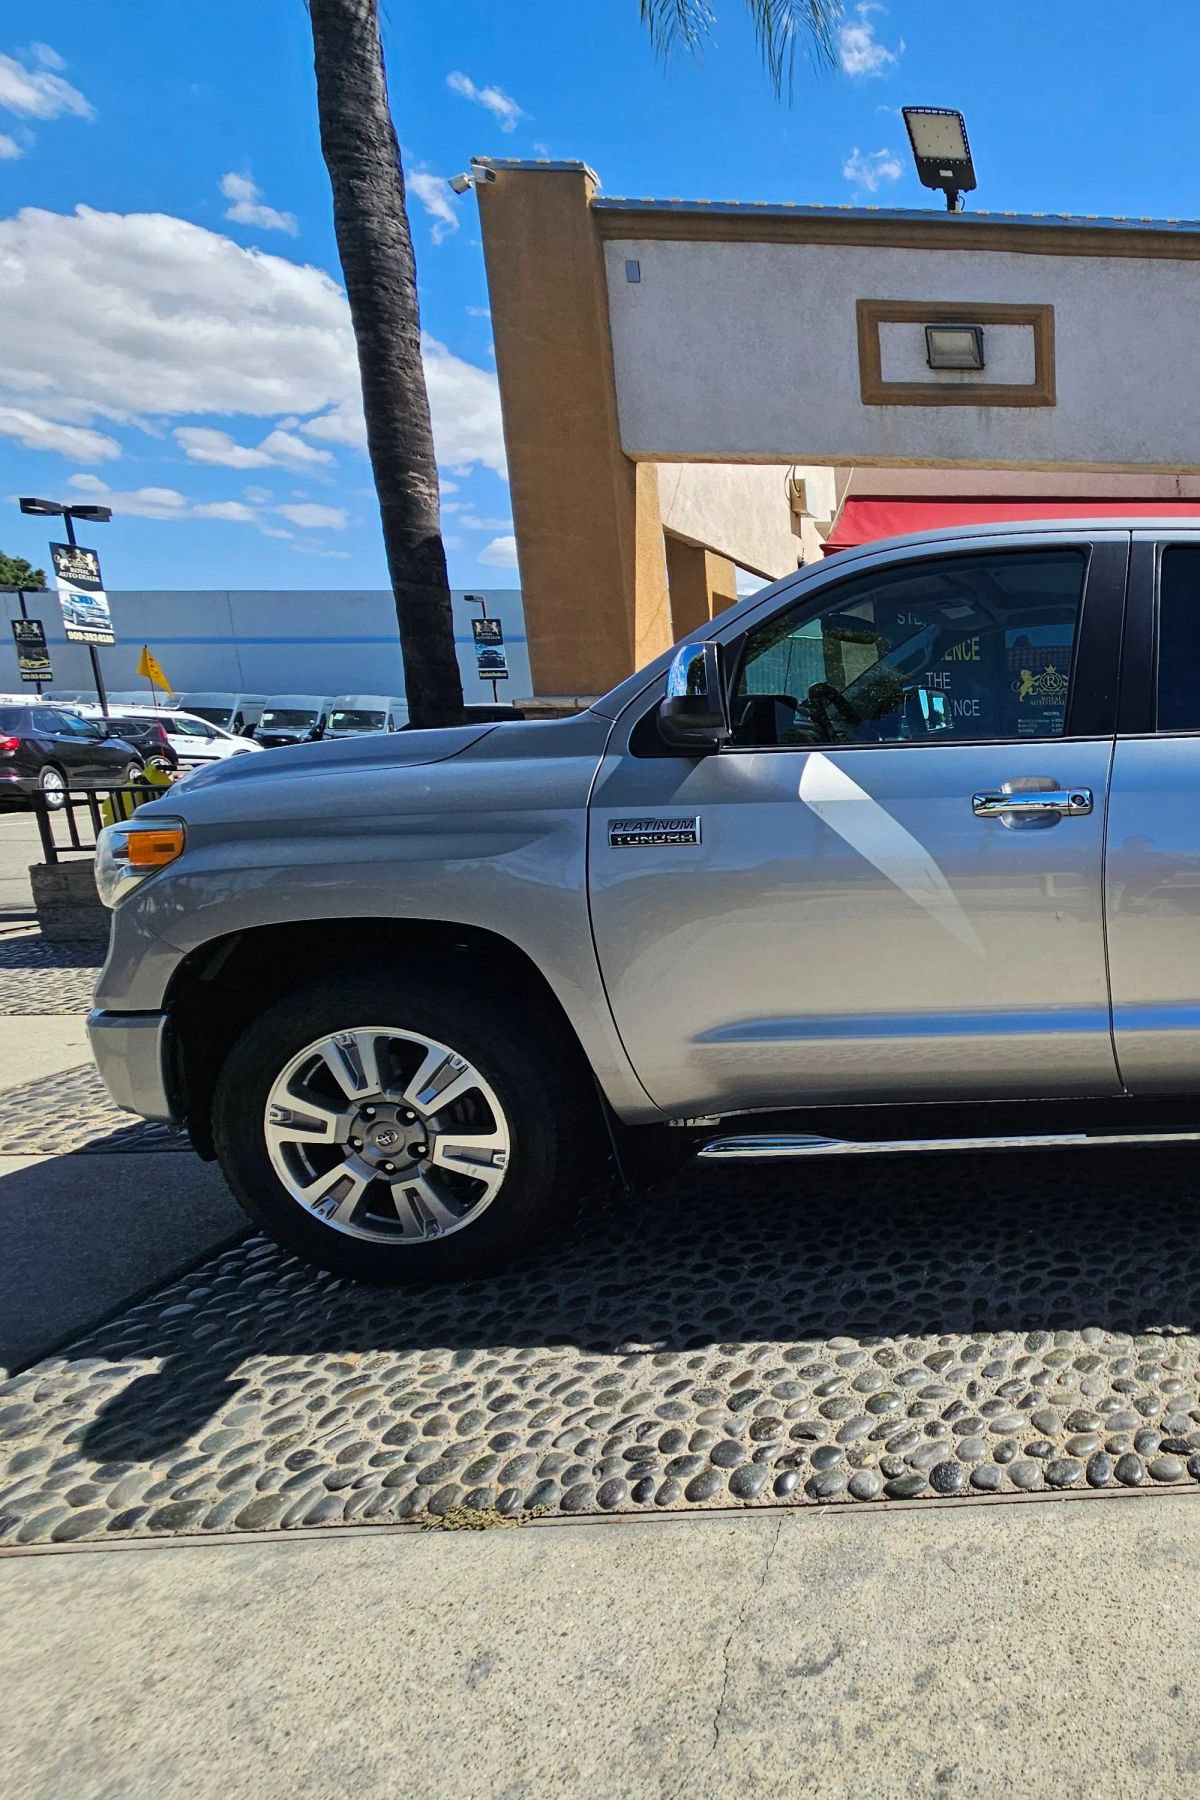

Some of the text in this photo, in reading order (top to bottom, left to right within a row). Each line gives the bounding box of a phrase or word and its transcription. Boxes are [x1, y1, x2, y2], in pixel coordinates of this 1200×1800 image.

[925, 671, 952, 689] THE
[612, 820, 694, 832] PLATINUM
[615, 833, 694, 844] TUNDRA
